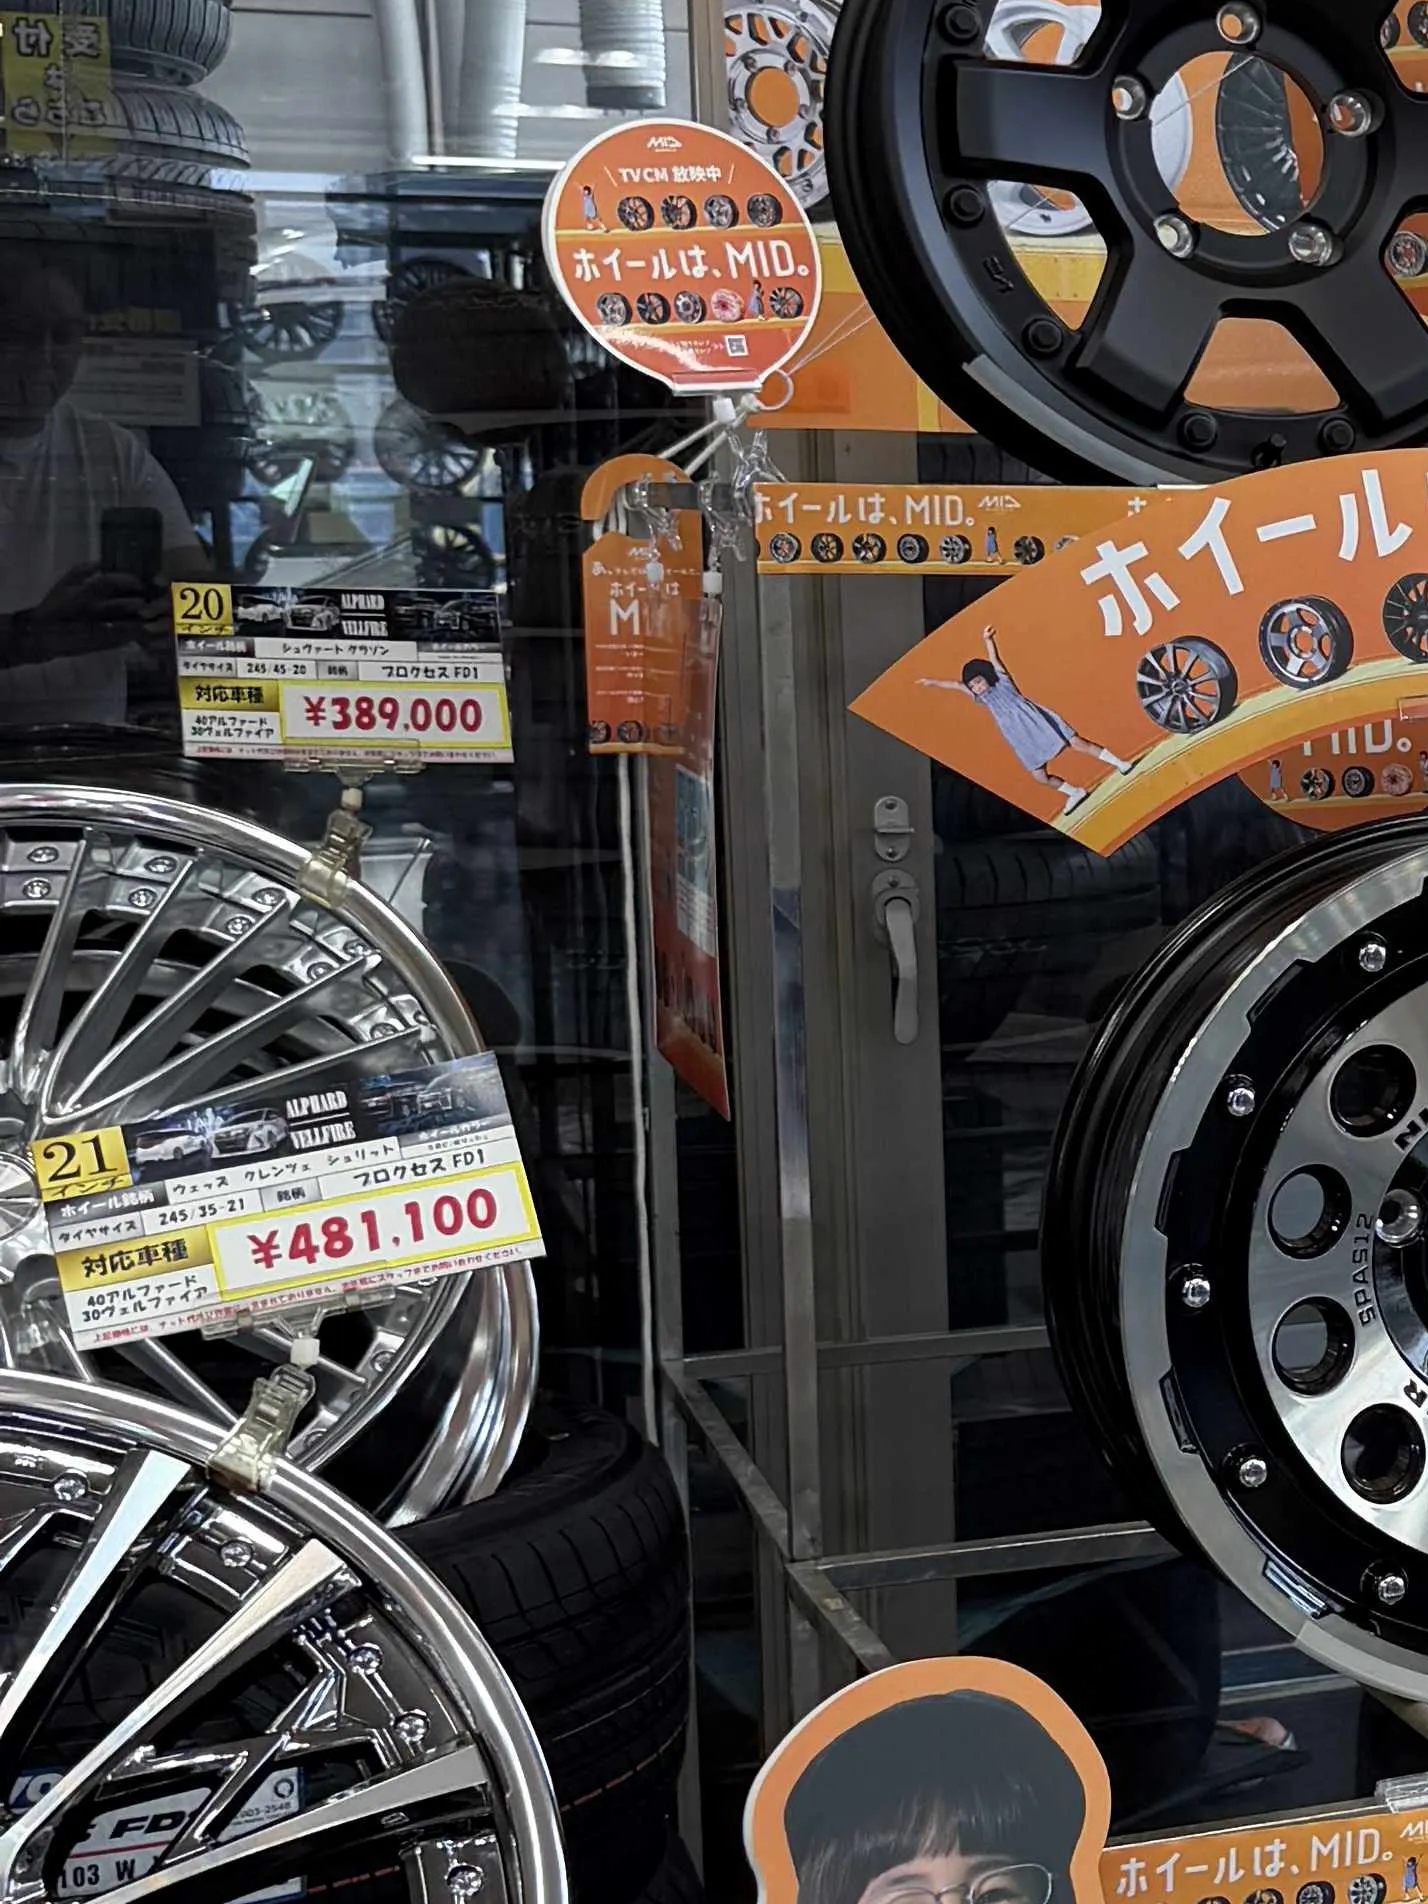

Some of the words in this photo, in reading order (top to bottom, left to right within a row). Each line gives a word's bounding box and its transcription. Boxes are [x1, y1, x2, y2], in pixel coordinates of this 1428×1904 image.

[572, 240, 811, 283] ホイールは、MID。
[180, 587, 223, 620] 20
[286, 1090, 348, 1119] ALPHARD
[290, 1121, 356, 1149] VELLFIRE
[43, 1137, 118, 1182] 21
[453, 1149, 485, 1171] FD1
[48, 1177, 124, 1197] インチ
[82, 1238, 189, 1278] 対応車種
[1351, 1212, 1374, 1328] SPAS12
[1116, 1828, 1393, 1896] ホイールは、MID。
